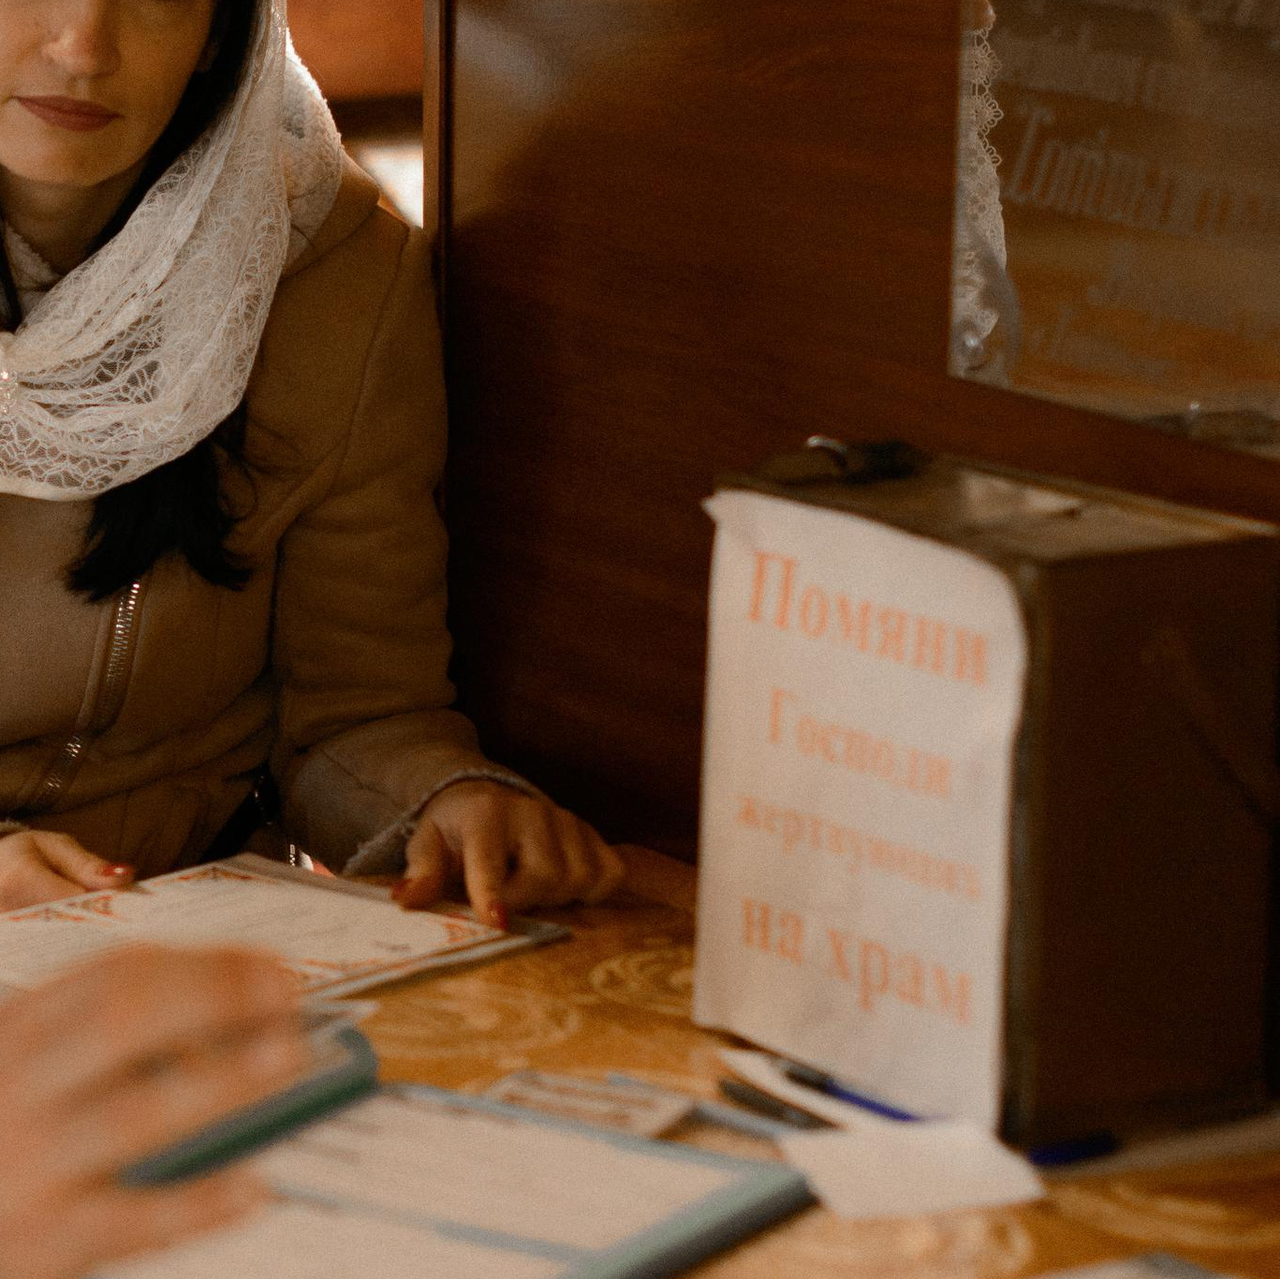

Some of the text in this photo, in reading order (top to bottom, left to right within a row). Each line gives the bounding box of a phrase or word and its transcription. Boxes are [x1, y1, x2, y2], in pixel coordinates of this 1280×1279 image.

[745, 549, 989, 688] Помяни
[766, 687, 952, 803] Господи
[741, 895, 972, 1026] на храм
